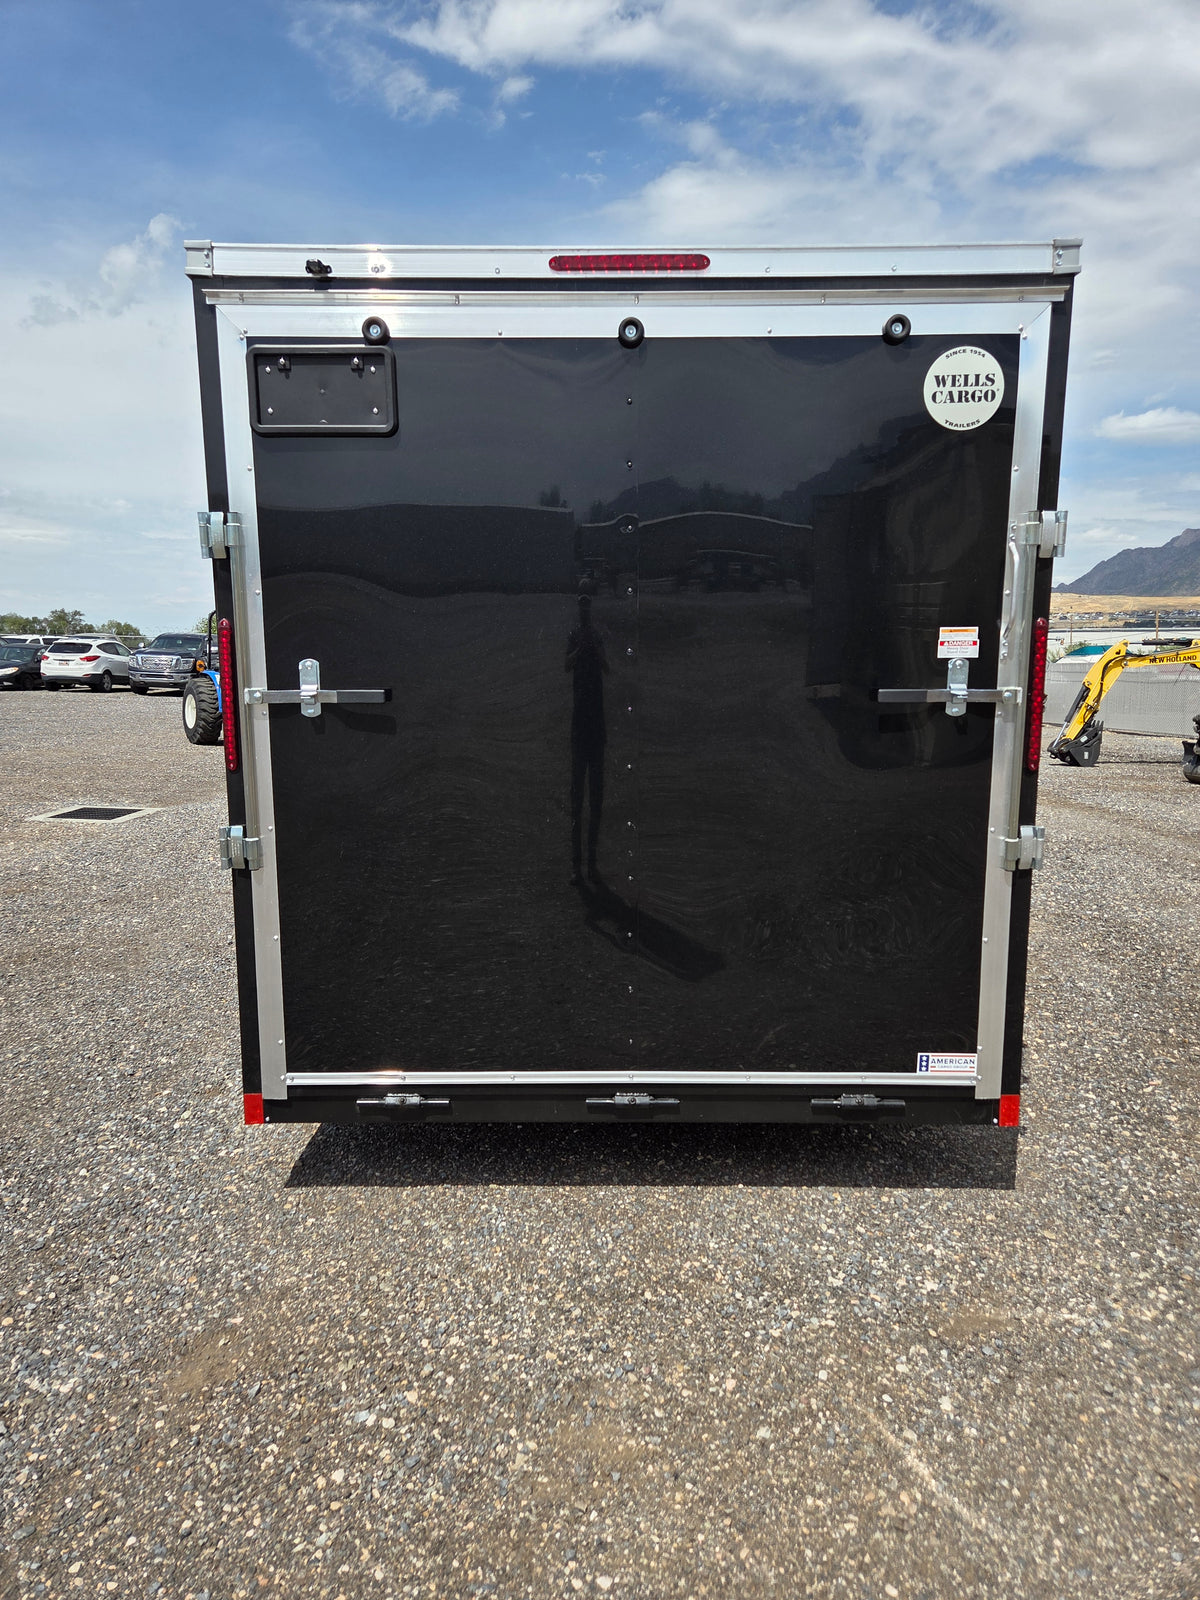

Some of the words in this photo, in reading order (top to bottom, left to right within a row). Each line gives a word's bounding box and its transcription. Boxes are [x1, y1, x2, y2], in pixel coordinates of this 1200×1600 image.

[945, 349, 967, 360] SINCE
[934, 373, 996, 388] WELLS
[931, 389, 996, 404] CARGO
[944, 419, 981, 428] TRAILERS
